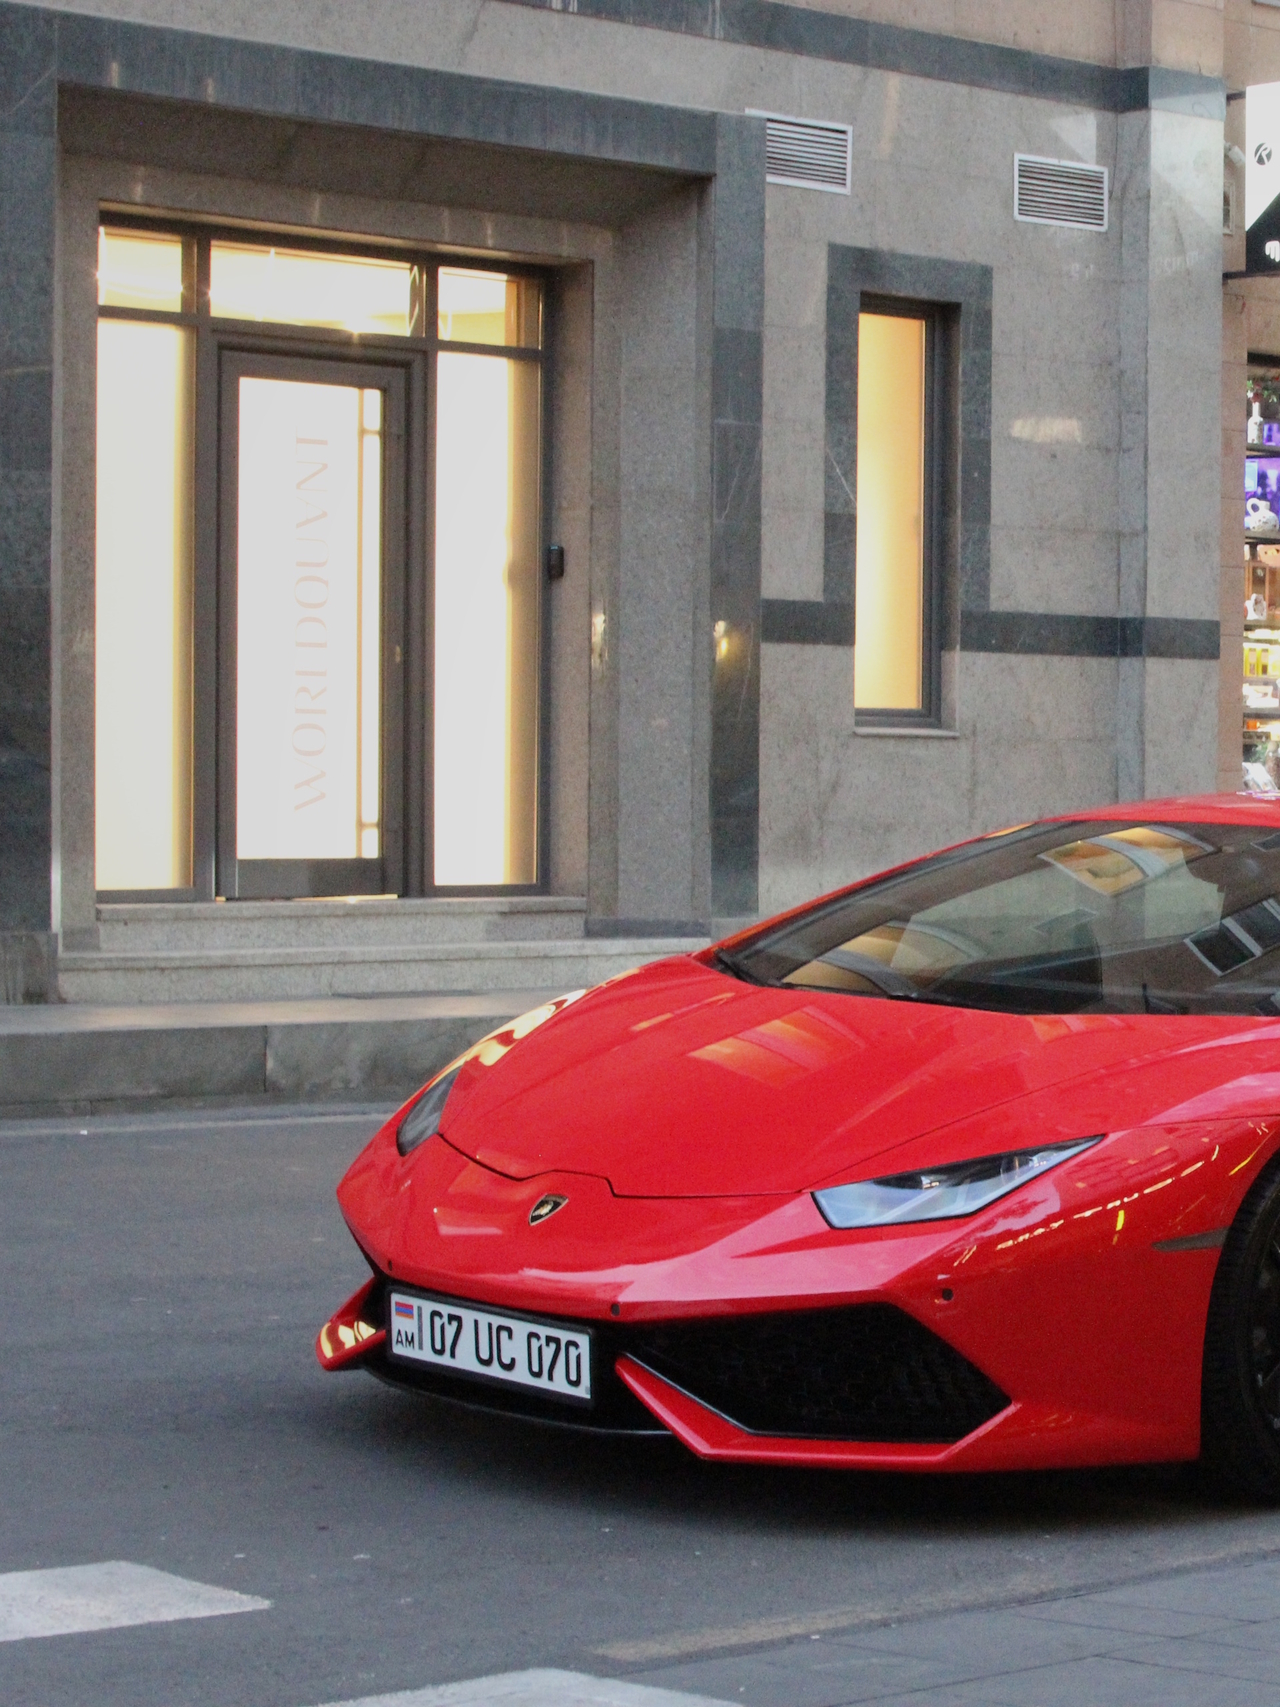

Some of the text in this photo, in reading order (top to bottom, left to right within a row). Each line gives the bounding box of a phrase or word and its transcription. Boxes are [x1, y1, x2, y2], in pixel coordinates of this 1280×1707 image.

[291, 426, 330, 813] WORLDQUANT
[395, 1328, 415, 1350] AM
[429, 1309, 582, 1388] 07 UC 070
